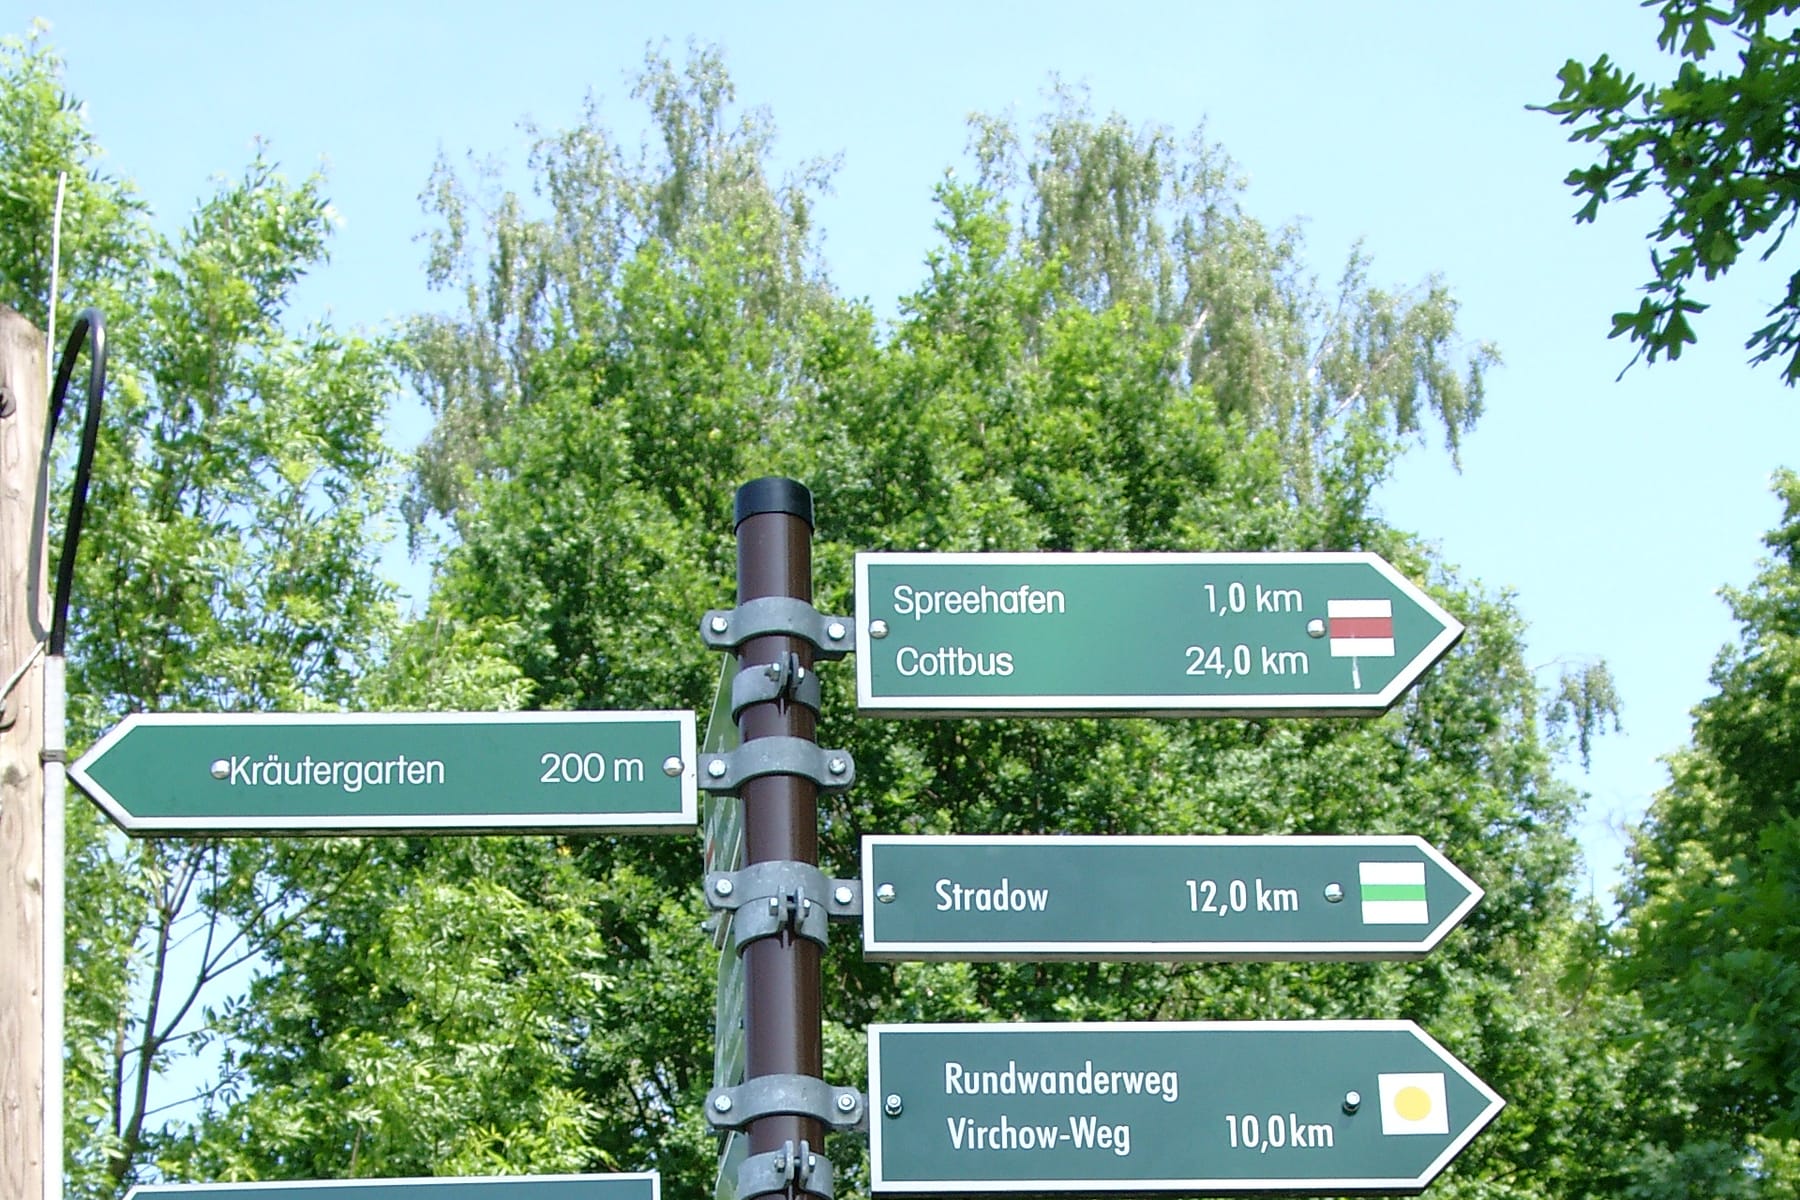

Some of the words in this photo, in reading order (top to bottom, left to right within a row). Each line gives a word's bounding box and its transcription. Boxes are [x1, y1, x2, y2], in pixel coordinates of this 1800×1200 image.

[895, 585, 1064, 620] Spreehafen
[1205, 583, 1245, 616] 1,0
[1256, 585, 1302, 611] km
[897, 647, 1013, 675] Cottbus
[1186, 645, 1250, 678] 24,0
[1262, 647, 1308, 674] km
[231, 755, 444, 792] Kräutergarten
[541, 753, 604, 782] 200
[615, 759, 643, 781] m
[936, 879, 1048, 910] Stradow
[1187, 880, 1246, 916] 12,0
[1256, 879, 1298, 911] km
[946, 1061, 1177, 1101] Rundwanderweg
[948, 1116, 1129, 1155] Virchow-Weg
